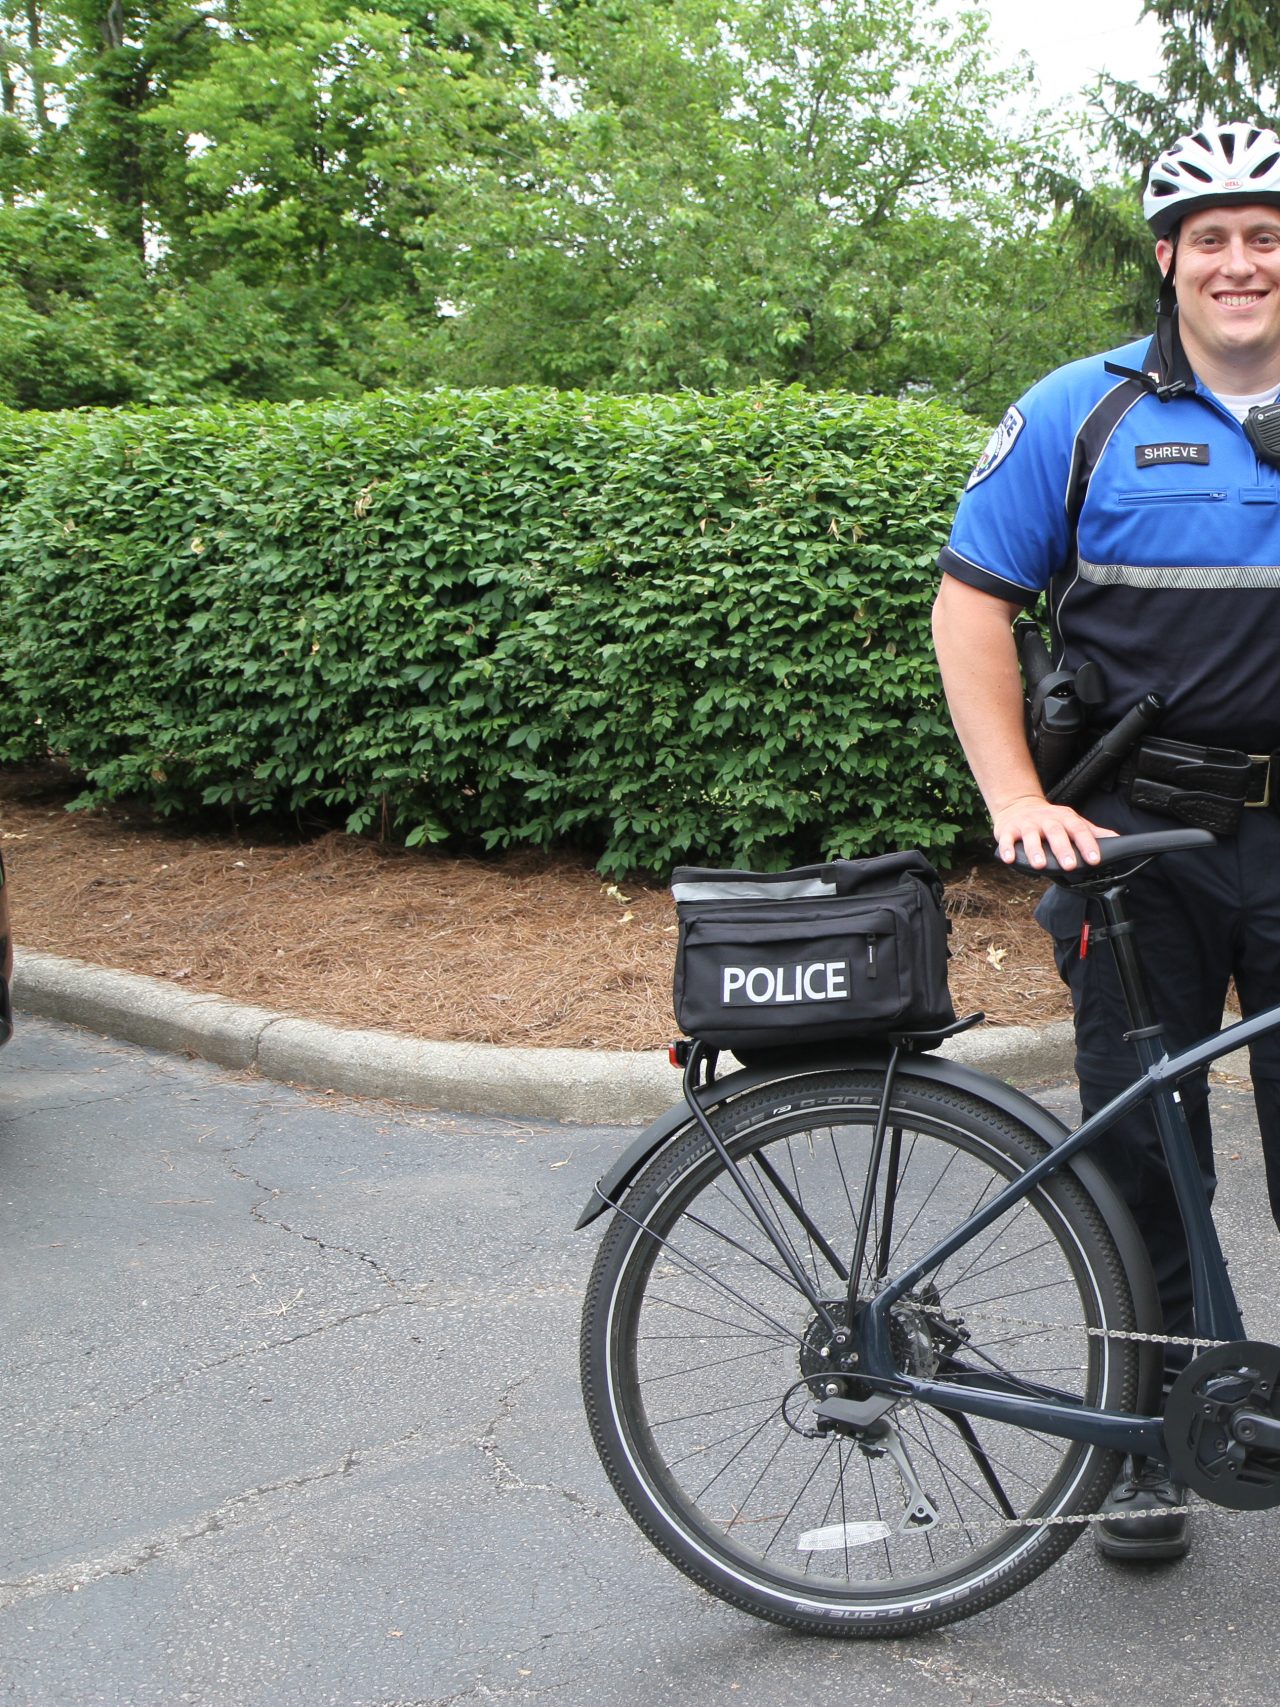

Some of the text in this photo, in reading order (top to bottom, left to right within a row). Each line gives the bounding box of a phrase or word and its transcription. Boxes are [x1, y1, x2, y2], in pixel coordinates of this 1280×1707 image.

[1144, 446, 1199, 460] SHREVE
[723, 962, 848, 1003] POLICE
[829, 1528, 1051, 1619] SCHWALBE G-ONE
